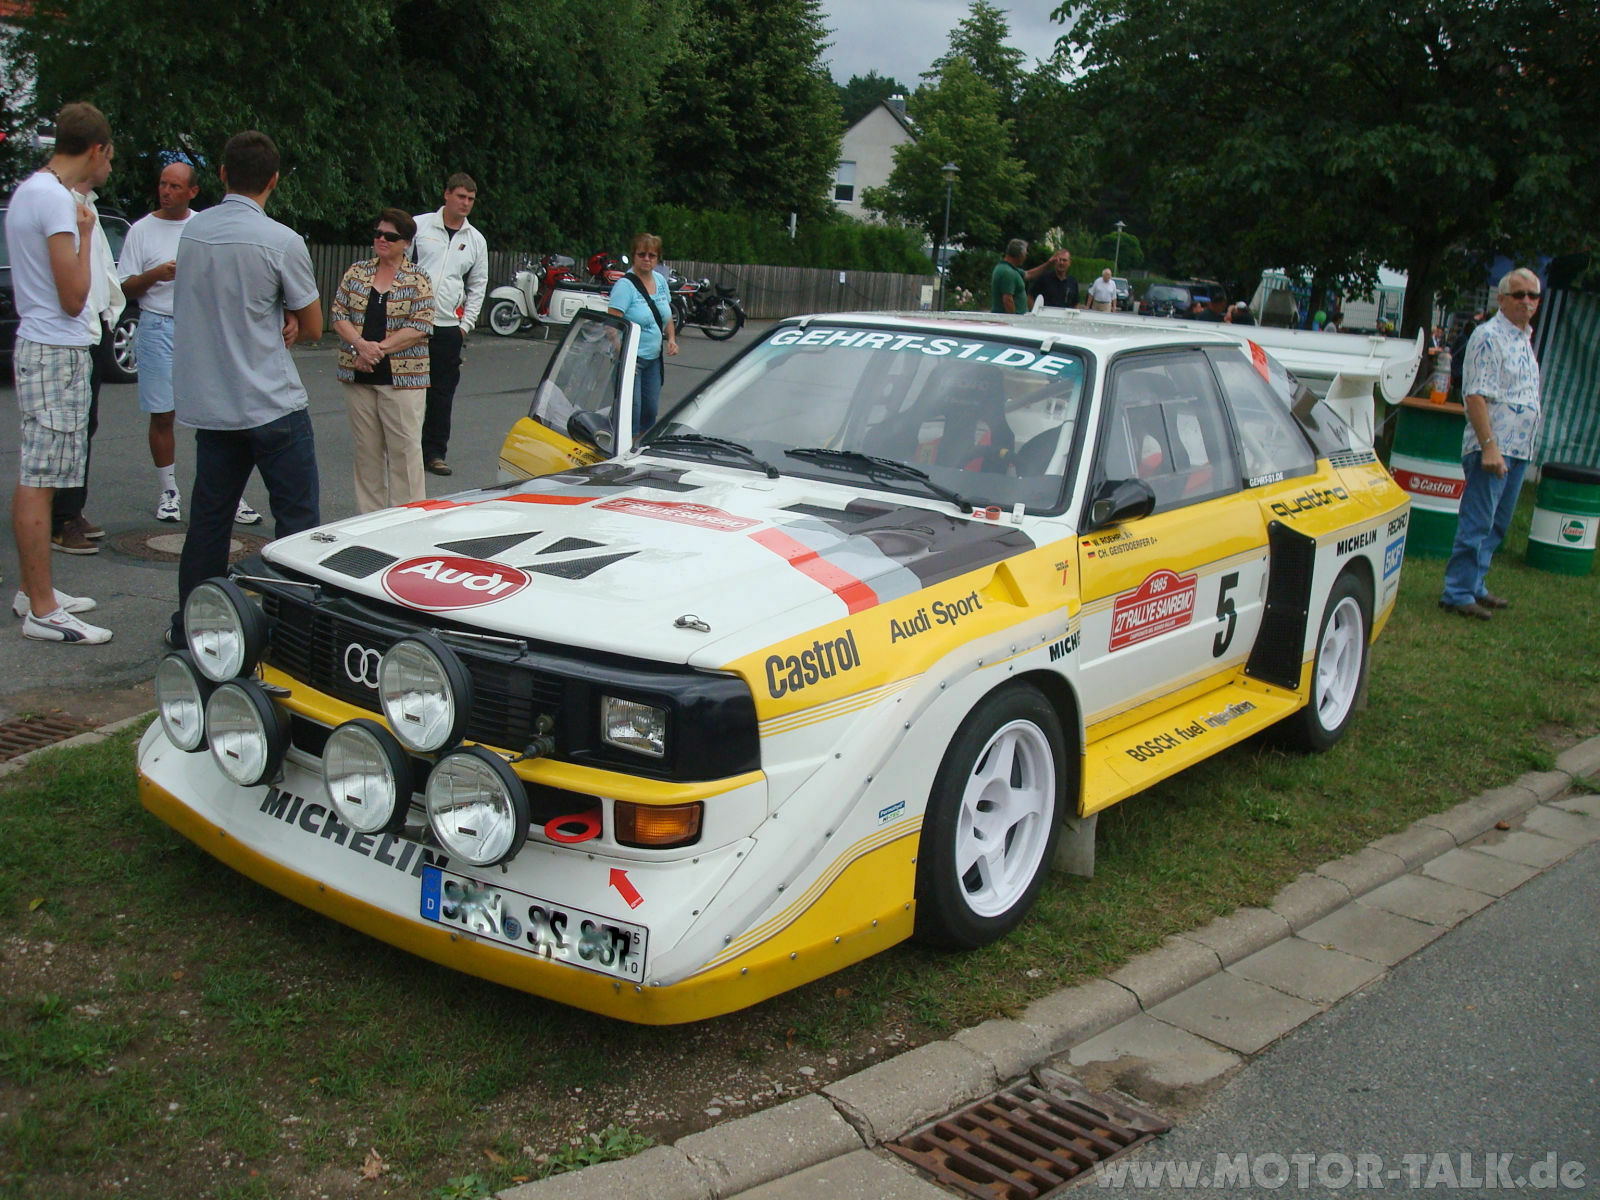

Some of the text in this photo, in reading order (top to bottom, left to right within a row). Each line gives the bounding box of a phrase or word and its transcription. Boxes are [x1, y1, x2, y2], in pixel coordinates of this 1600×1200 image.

[770, 330, 1073, 375] GEHRT-S1.DE
[1271, 487, 1348, 519] quattro
[1420, 479, 1456, 495] Castrol
[1098, 549, 1109, 559] CH.
[1109, 538, 1150, 555] GEISTDOERFER
[1336, 529, 1378, 557] MICHELIN
[1384, 543, 1403, 575] SKF
[398, 560, 514, 595] Audi
[1149, 576, 1168, 595] 1985
[890, 591, 982, 644] Audi Sport
[1125, 601, 1157, 630] RALLYE
[1155, 590, 1193, 620] SANREMO
[1213, 571, 1239, 658] 5
[765, 629, 861, 699] Castrol
[1125, 733, 1181, 762] BOSCH
[1174, 720, 1207, 740] fuel
[259, 787, 450, 879] MICHELIN
[426, 898, 435, 910] D
